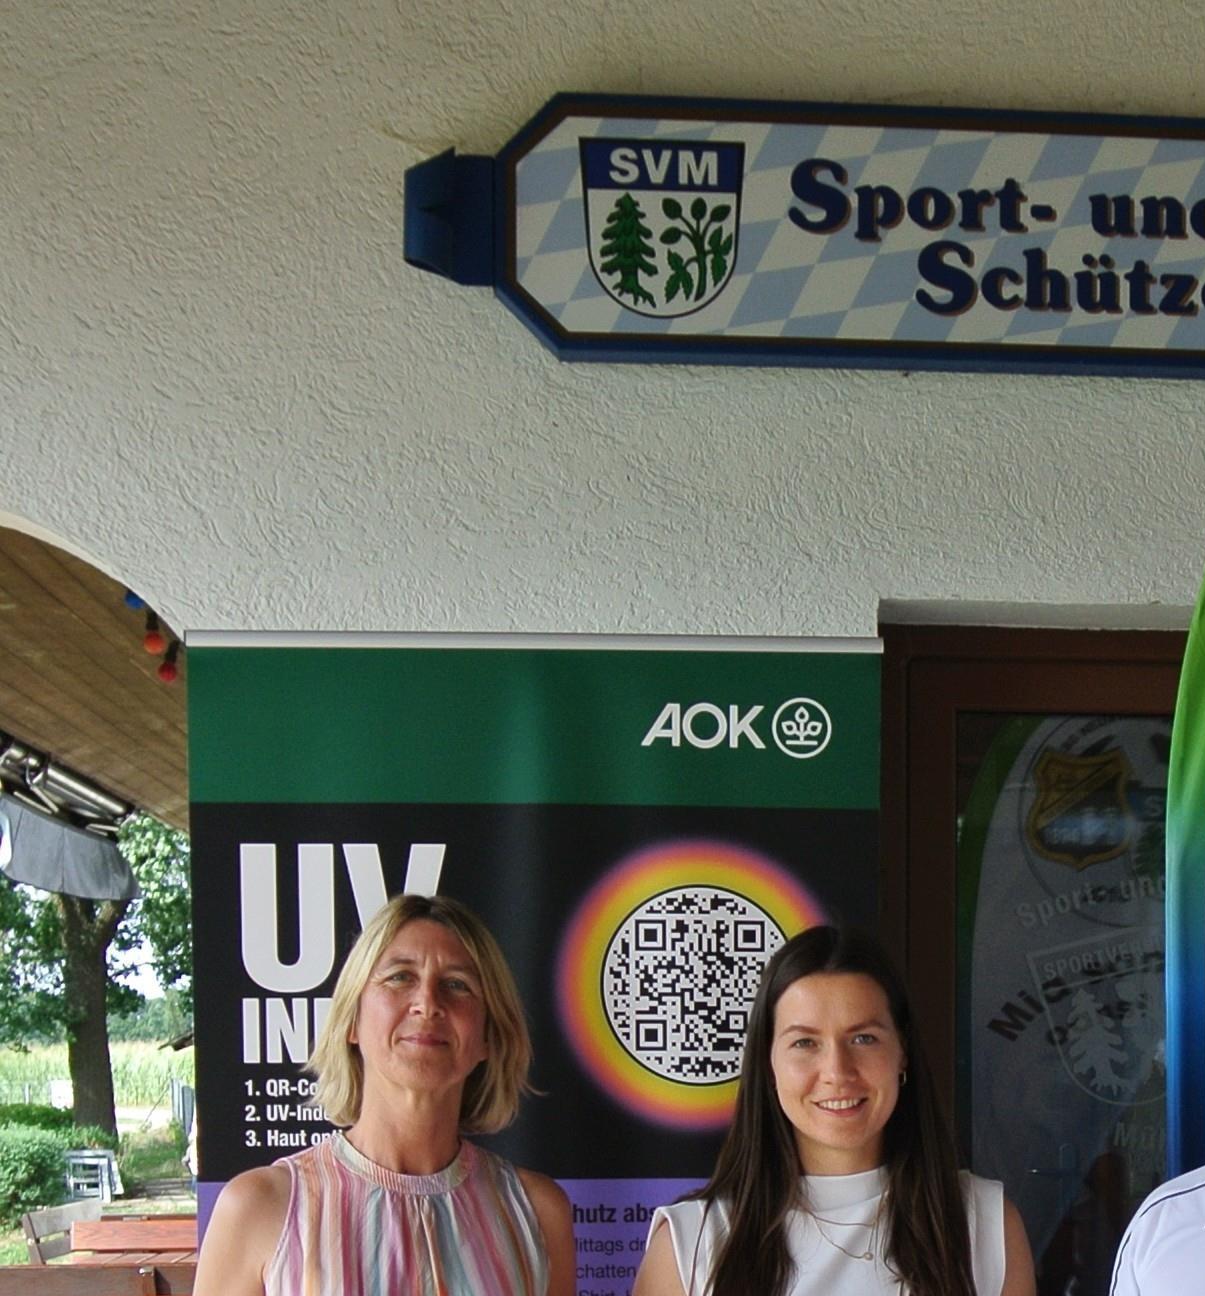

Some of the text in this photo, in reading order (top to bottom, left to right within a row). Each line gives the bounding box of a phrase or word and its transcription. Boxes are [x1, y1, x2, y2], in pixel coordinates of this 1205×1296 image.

[608, 146, 720, 187] SVM
[788, 157, 1058, 242] Sport-
[641, 702, 766, 750] AOK
[244, 1079, 261, 1097] 1.
[244, 1104, 261, 1122] 2.
[245, 1129, 261, 1147] 3.
[267, 1129, 307, 1147] Haut
[575, 1237, 625, 1256] ittags
